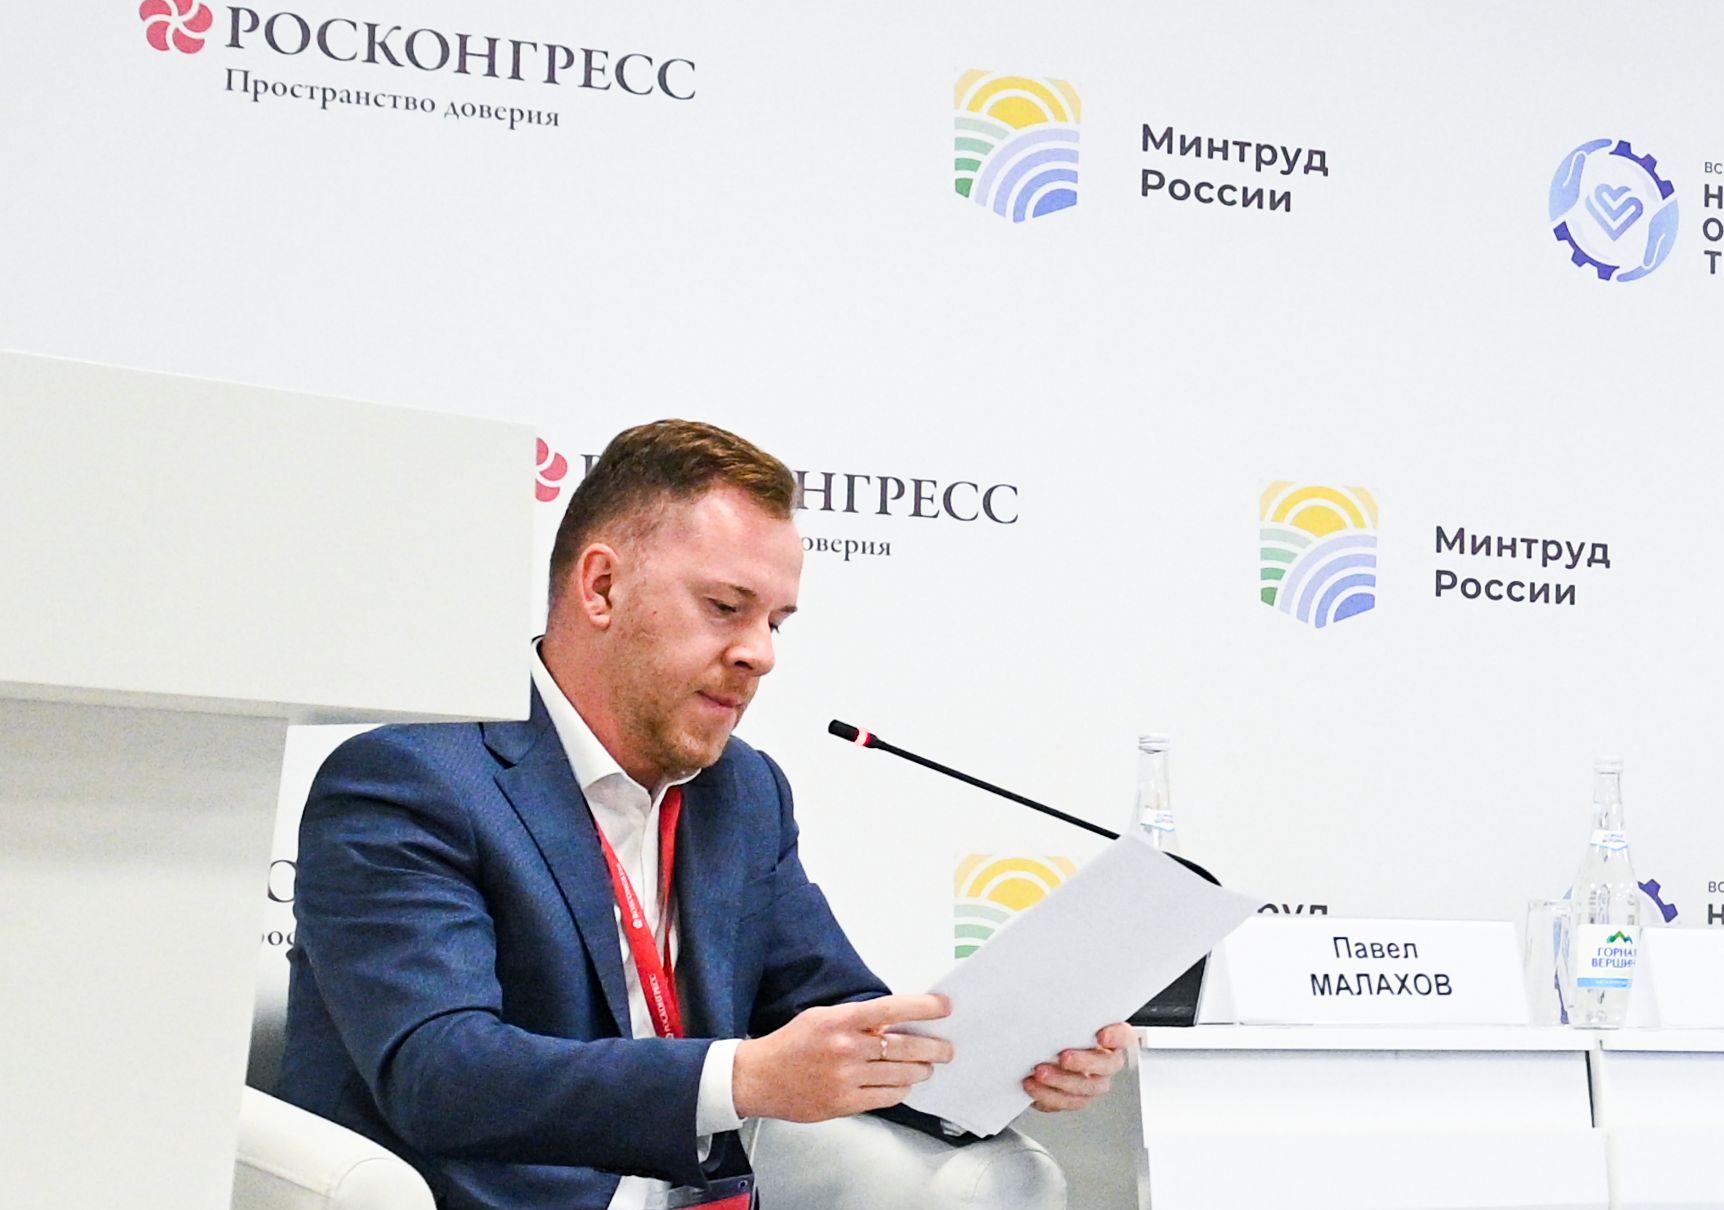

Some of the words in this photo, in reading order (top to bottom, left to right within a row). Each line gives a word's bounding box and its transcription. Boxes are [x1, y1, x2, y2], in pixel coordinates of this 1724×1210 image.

[226, 6, 695, 100] РОСКОНГРЕСС
[227, 69, 435, 112] Пространство
[444, 102, 558, 130] доверия
[1143, 124, 1328, 176] Минтруд
[1142, 169, 1291, 212] России
[801, 536, 892, 561] оверия
[1436, 526, 1610, 569] Минтруд
[1436, 570, 1575, 605] России
[1333, 937, 1417, 958] Павел
[1311, 974, 1452, 995] МАЛАХОВ
